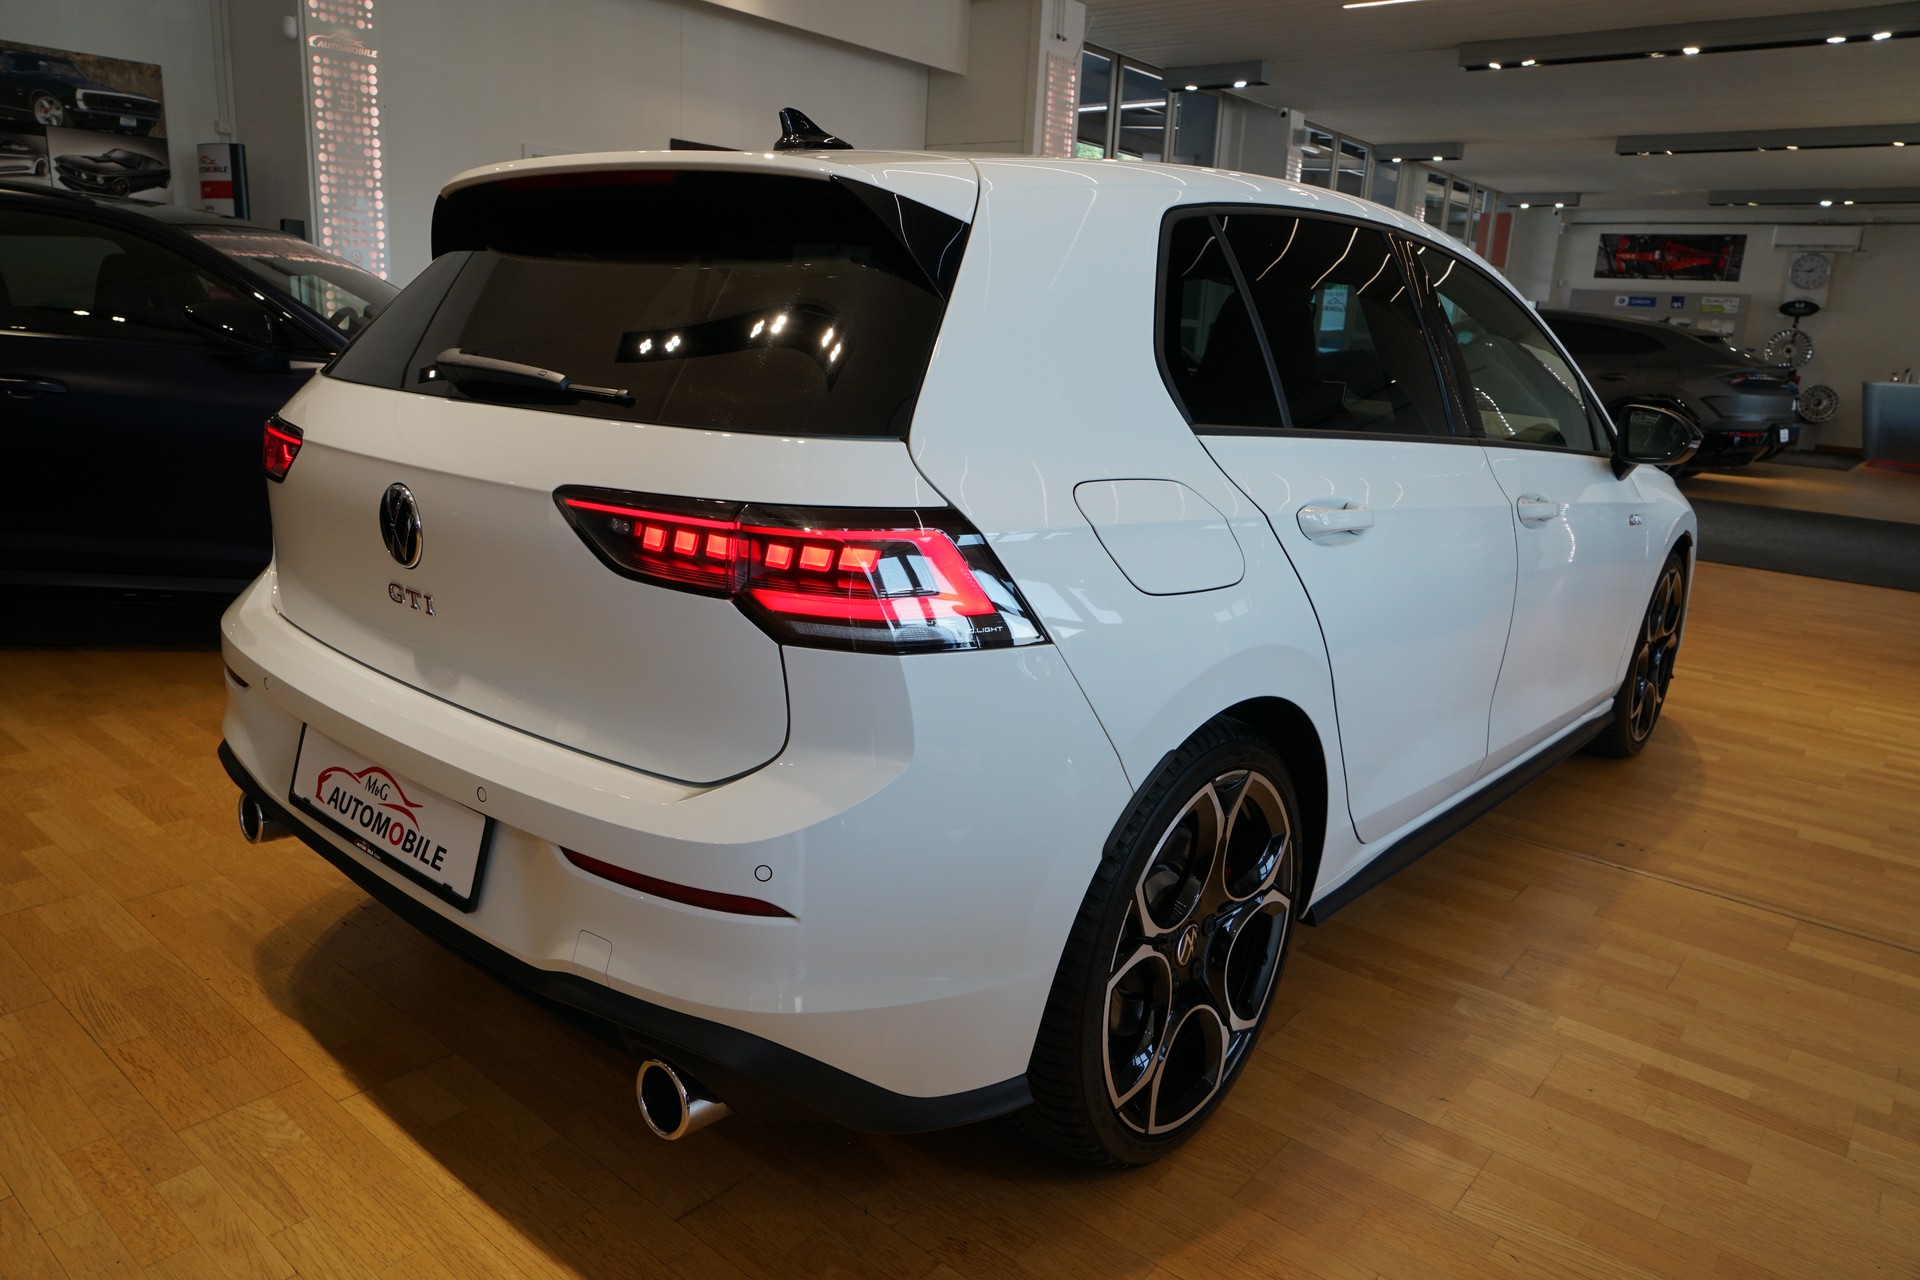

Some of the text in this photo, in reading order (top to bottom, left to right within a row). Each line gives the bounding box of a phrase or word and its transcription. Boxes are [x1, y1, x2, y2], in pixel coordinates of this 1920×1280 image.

[317, 40, 378, 58] AUTOMOBILE
[388, 582, 436, 617] GTI
[364, 774, 391, 802] M&G
[326, 786, 448, 872] AUTOMOBILE
